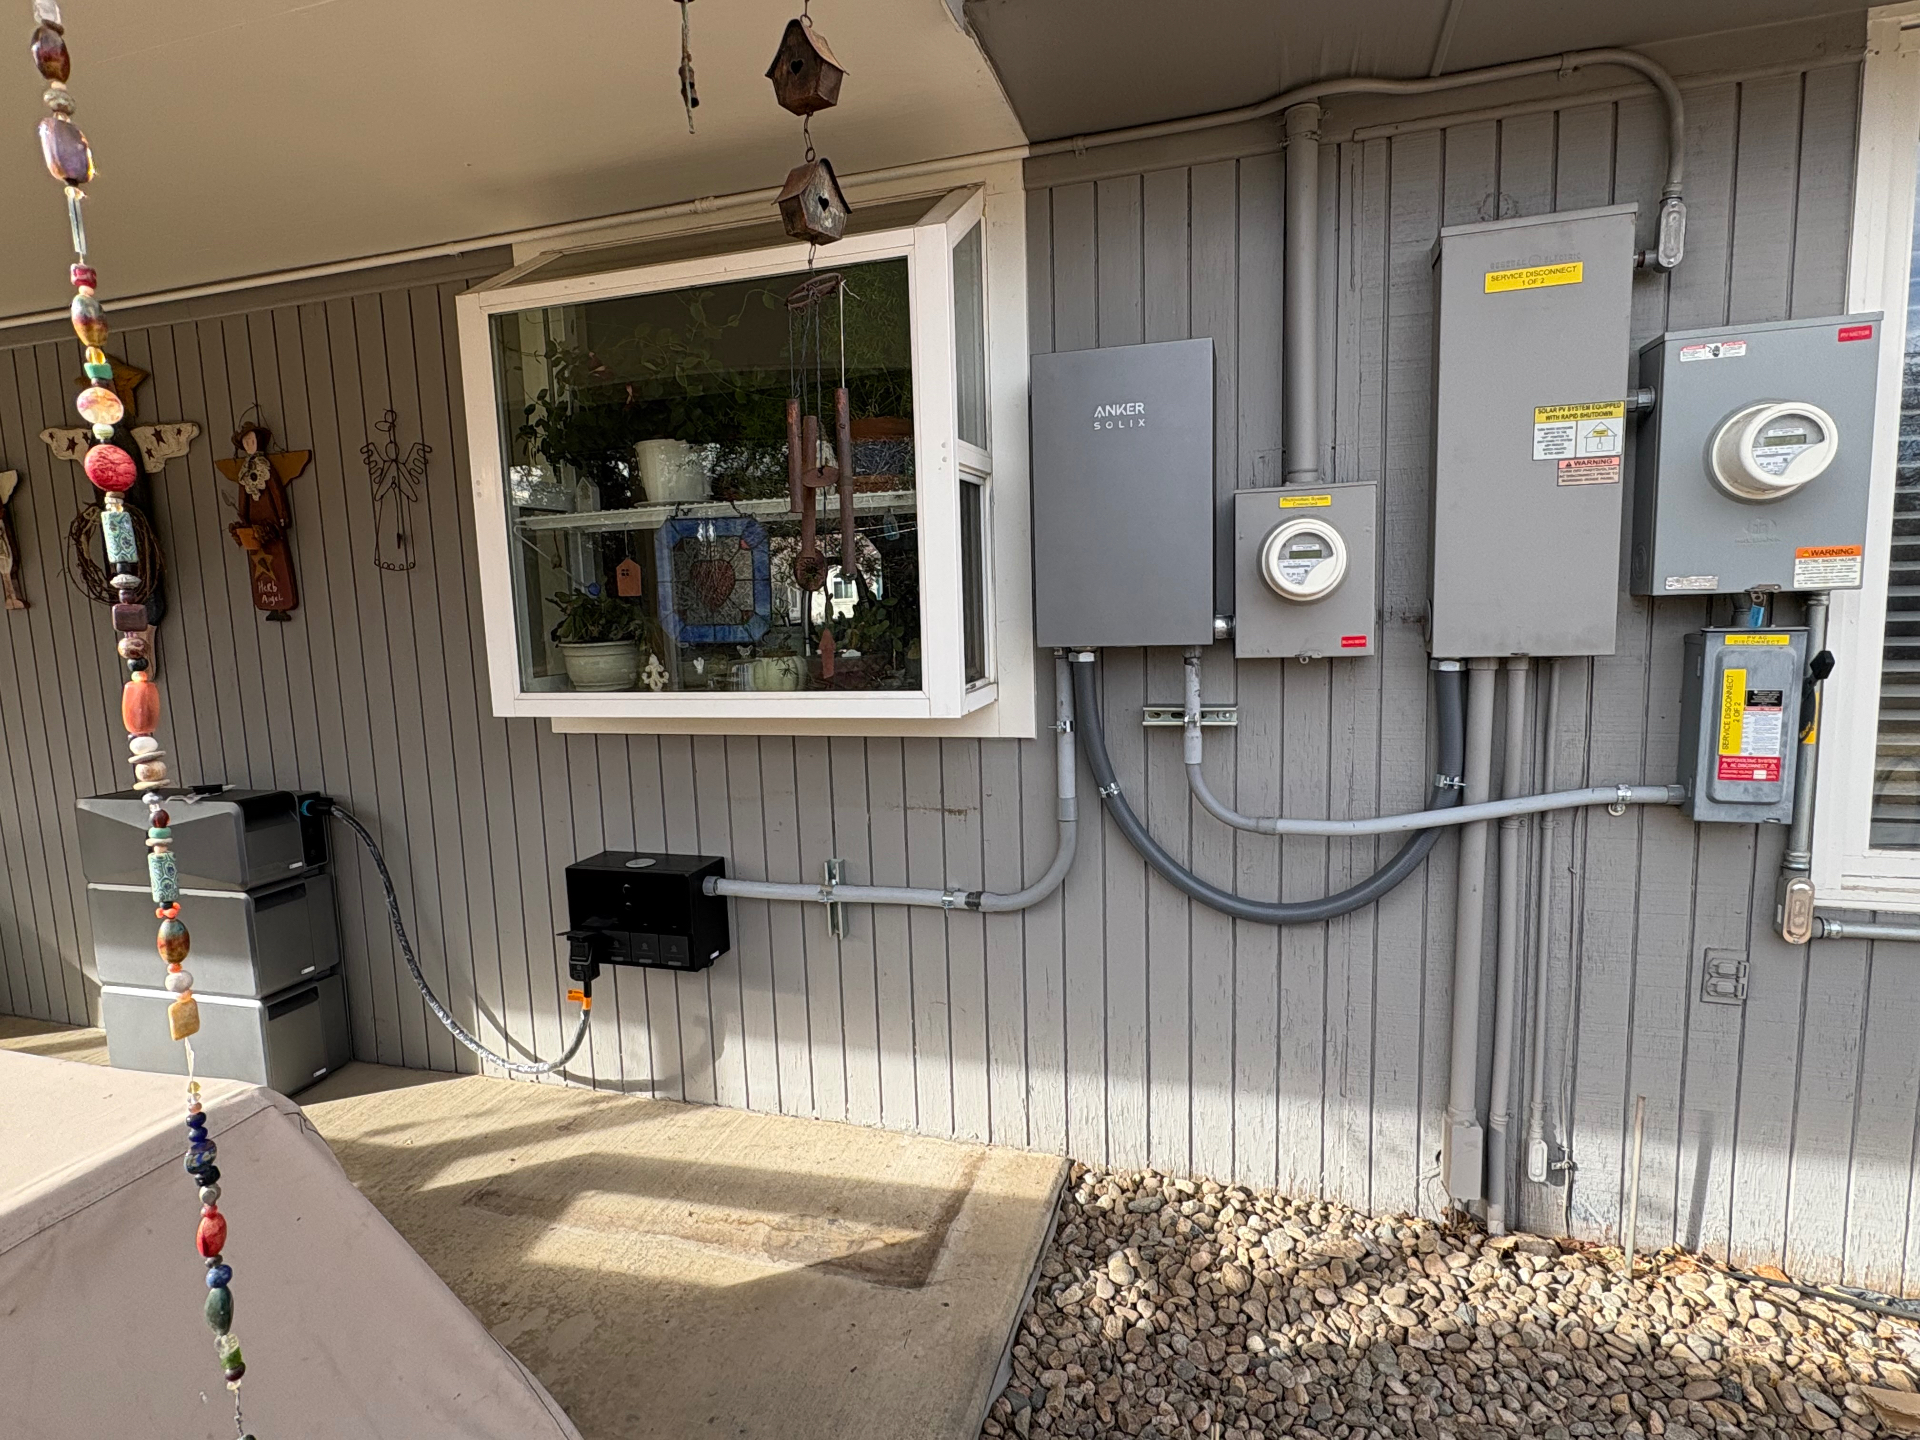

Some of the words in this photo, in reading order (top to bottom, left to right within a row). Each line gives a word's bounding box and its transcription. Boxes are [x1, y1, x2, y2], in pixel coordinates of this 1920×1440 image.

[1491, 271, 1523, 281] SERVICE
[1525, 265, 1577, 277] DISCONNECT
[1094, 402, 1145, 418] ANKER
[1538, 406, 1557, 414] SOLAR
[1567, 404, 1590, 412] SYSTEM
[1093, 419, 1145, 430] SOLIX
[1574, 458, 1612, 466] WARNING
[1811, 548, 1854, 556] WARNING
[1724, 674, 1734, 719] DISCONNECT
[1733, 707, 1740, 717] OF
[1722, 720, 1731, 750] SERVICE
